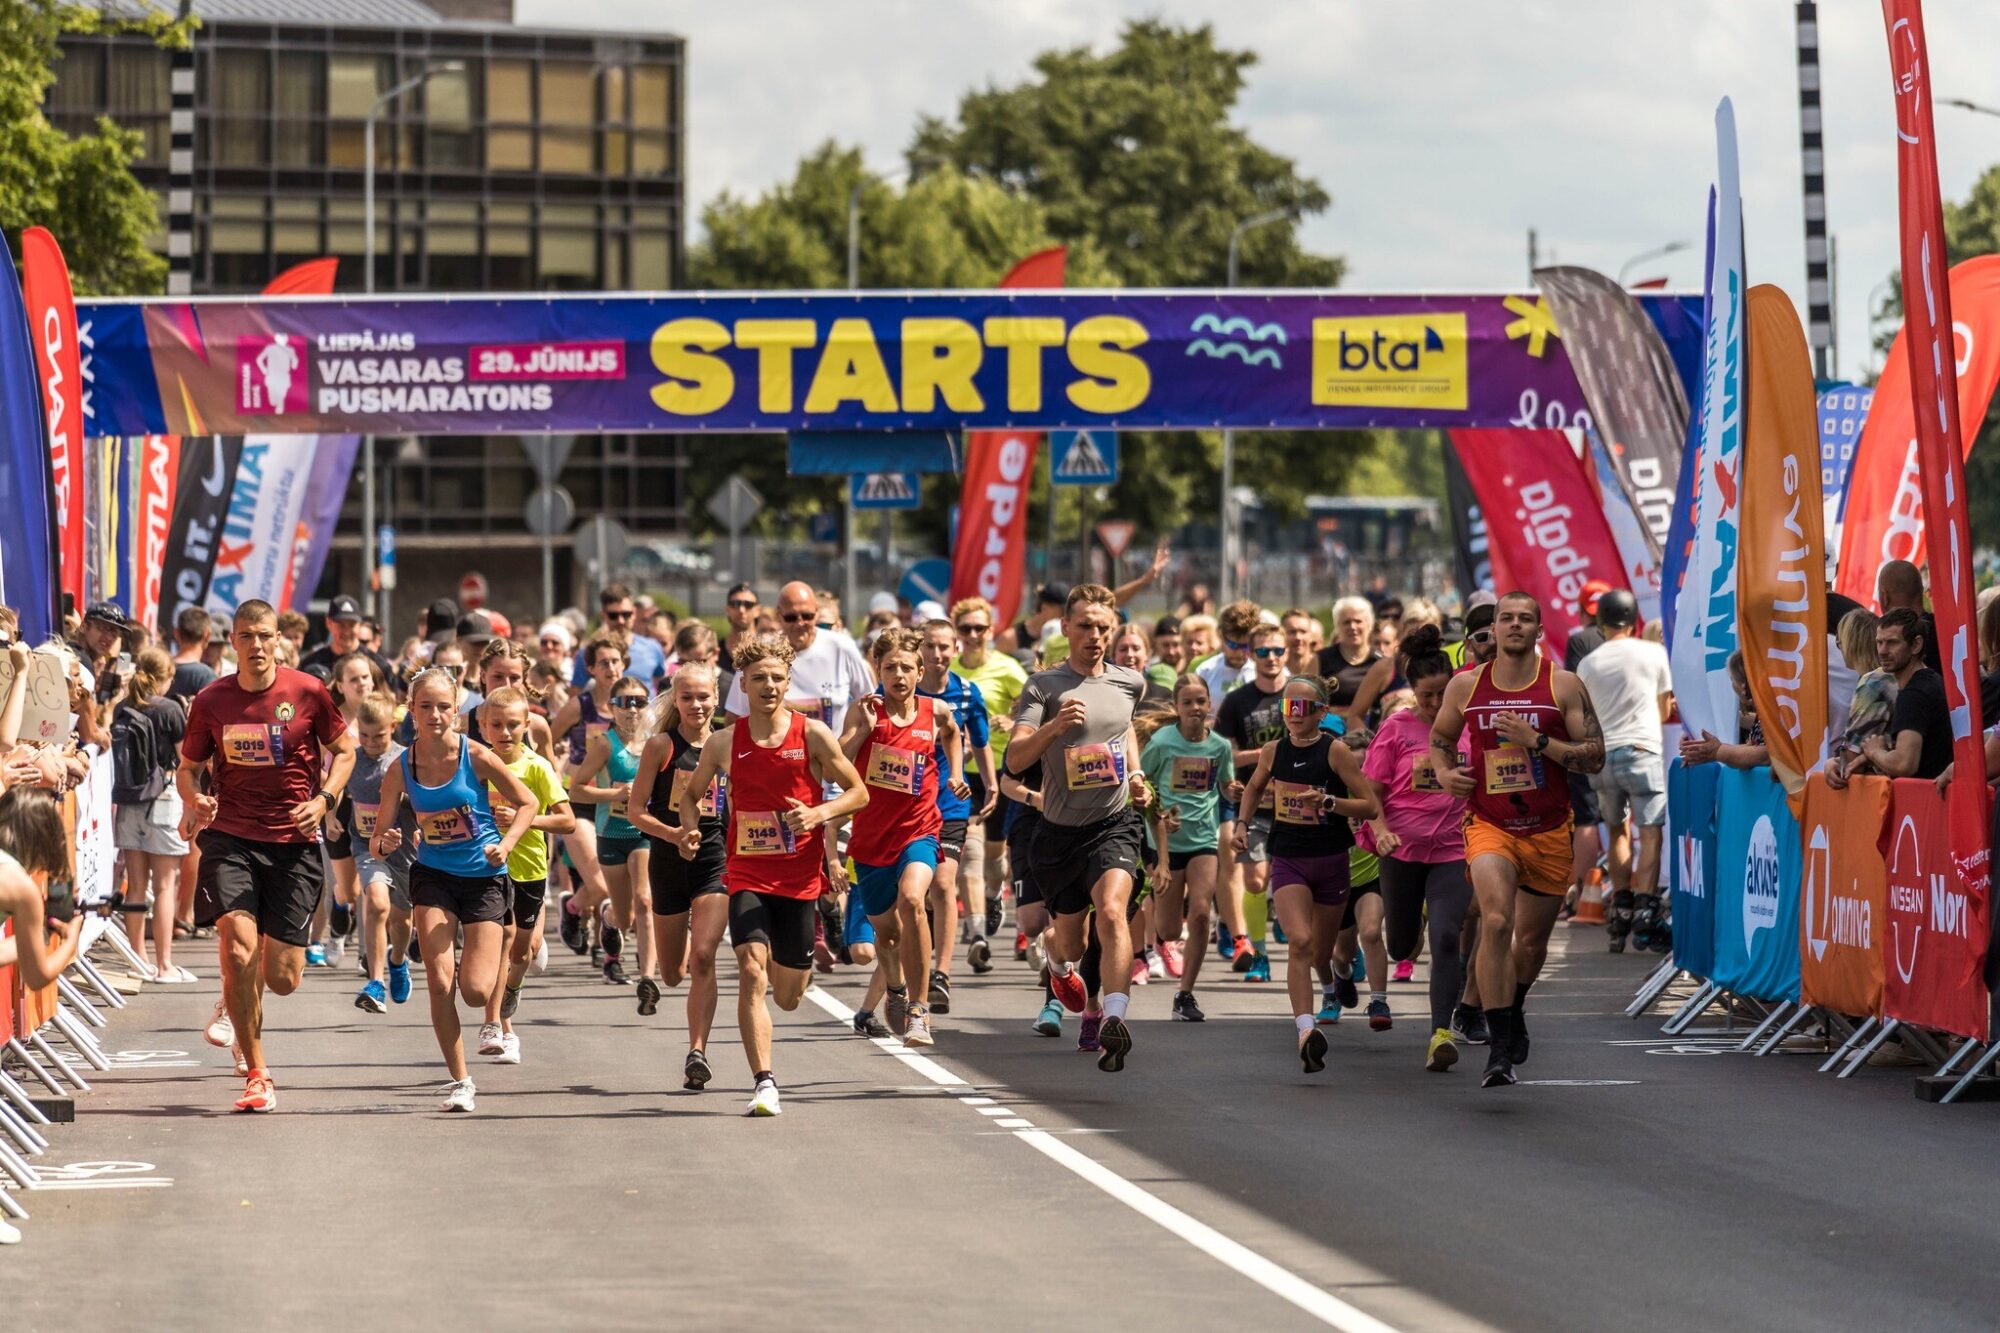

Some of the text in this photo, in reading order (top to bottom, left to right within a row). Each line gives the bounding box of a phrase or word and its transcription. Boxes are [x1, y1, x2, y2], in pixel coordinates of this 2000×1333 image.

[317, 330, 415, 352] LIEPĀJAS
[1339, 330, 1419, 371] bta
[317, 358, 464, 384] VASARAS
[478, 346, 618, 373] 29. JŪNIJS
[649, 315, 1151, 415] STARTS
[317, 385, 553, 413] PUSMARATONS
[1364, 384, 1416, 393] INSURANCE
[184, 513, 217, 562] IT.
[210, 443, 270, 620] AXIMA
[978, 437, 1027, 622] orde
[1516, 480, 1590, 636] iepāja
[234, 741, 265, 751] 3019
[879, 761, 910, 776] 3149
[1078, 759, 1110, 774] 3041
[1423, 768, 1437, 778] 30
[1282, 797, 1304, 808] 303
[433, 818, 459, 830] 3117
[748, 828, 777, 838] 3148
[1890, 884, 1924, 914] NISSAN
[1832, 878, 1871, 950] omniva
